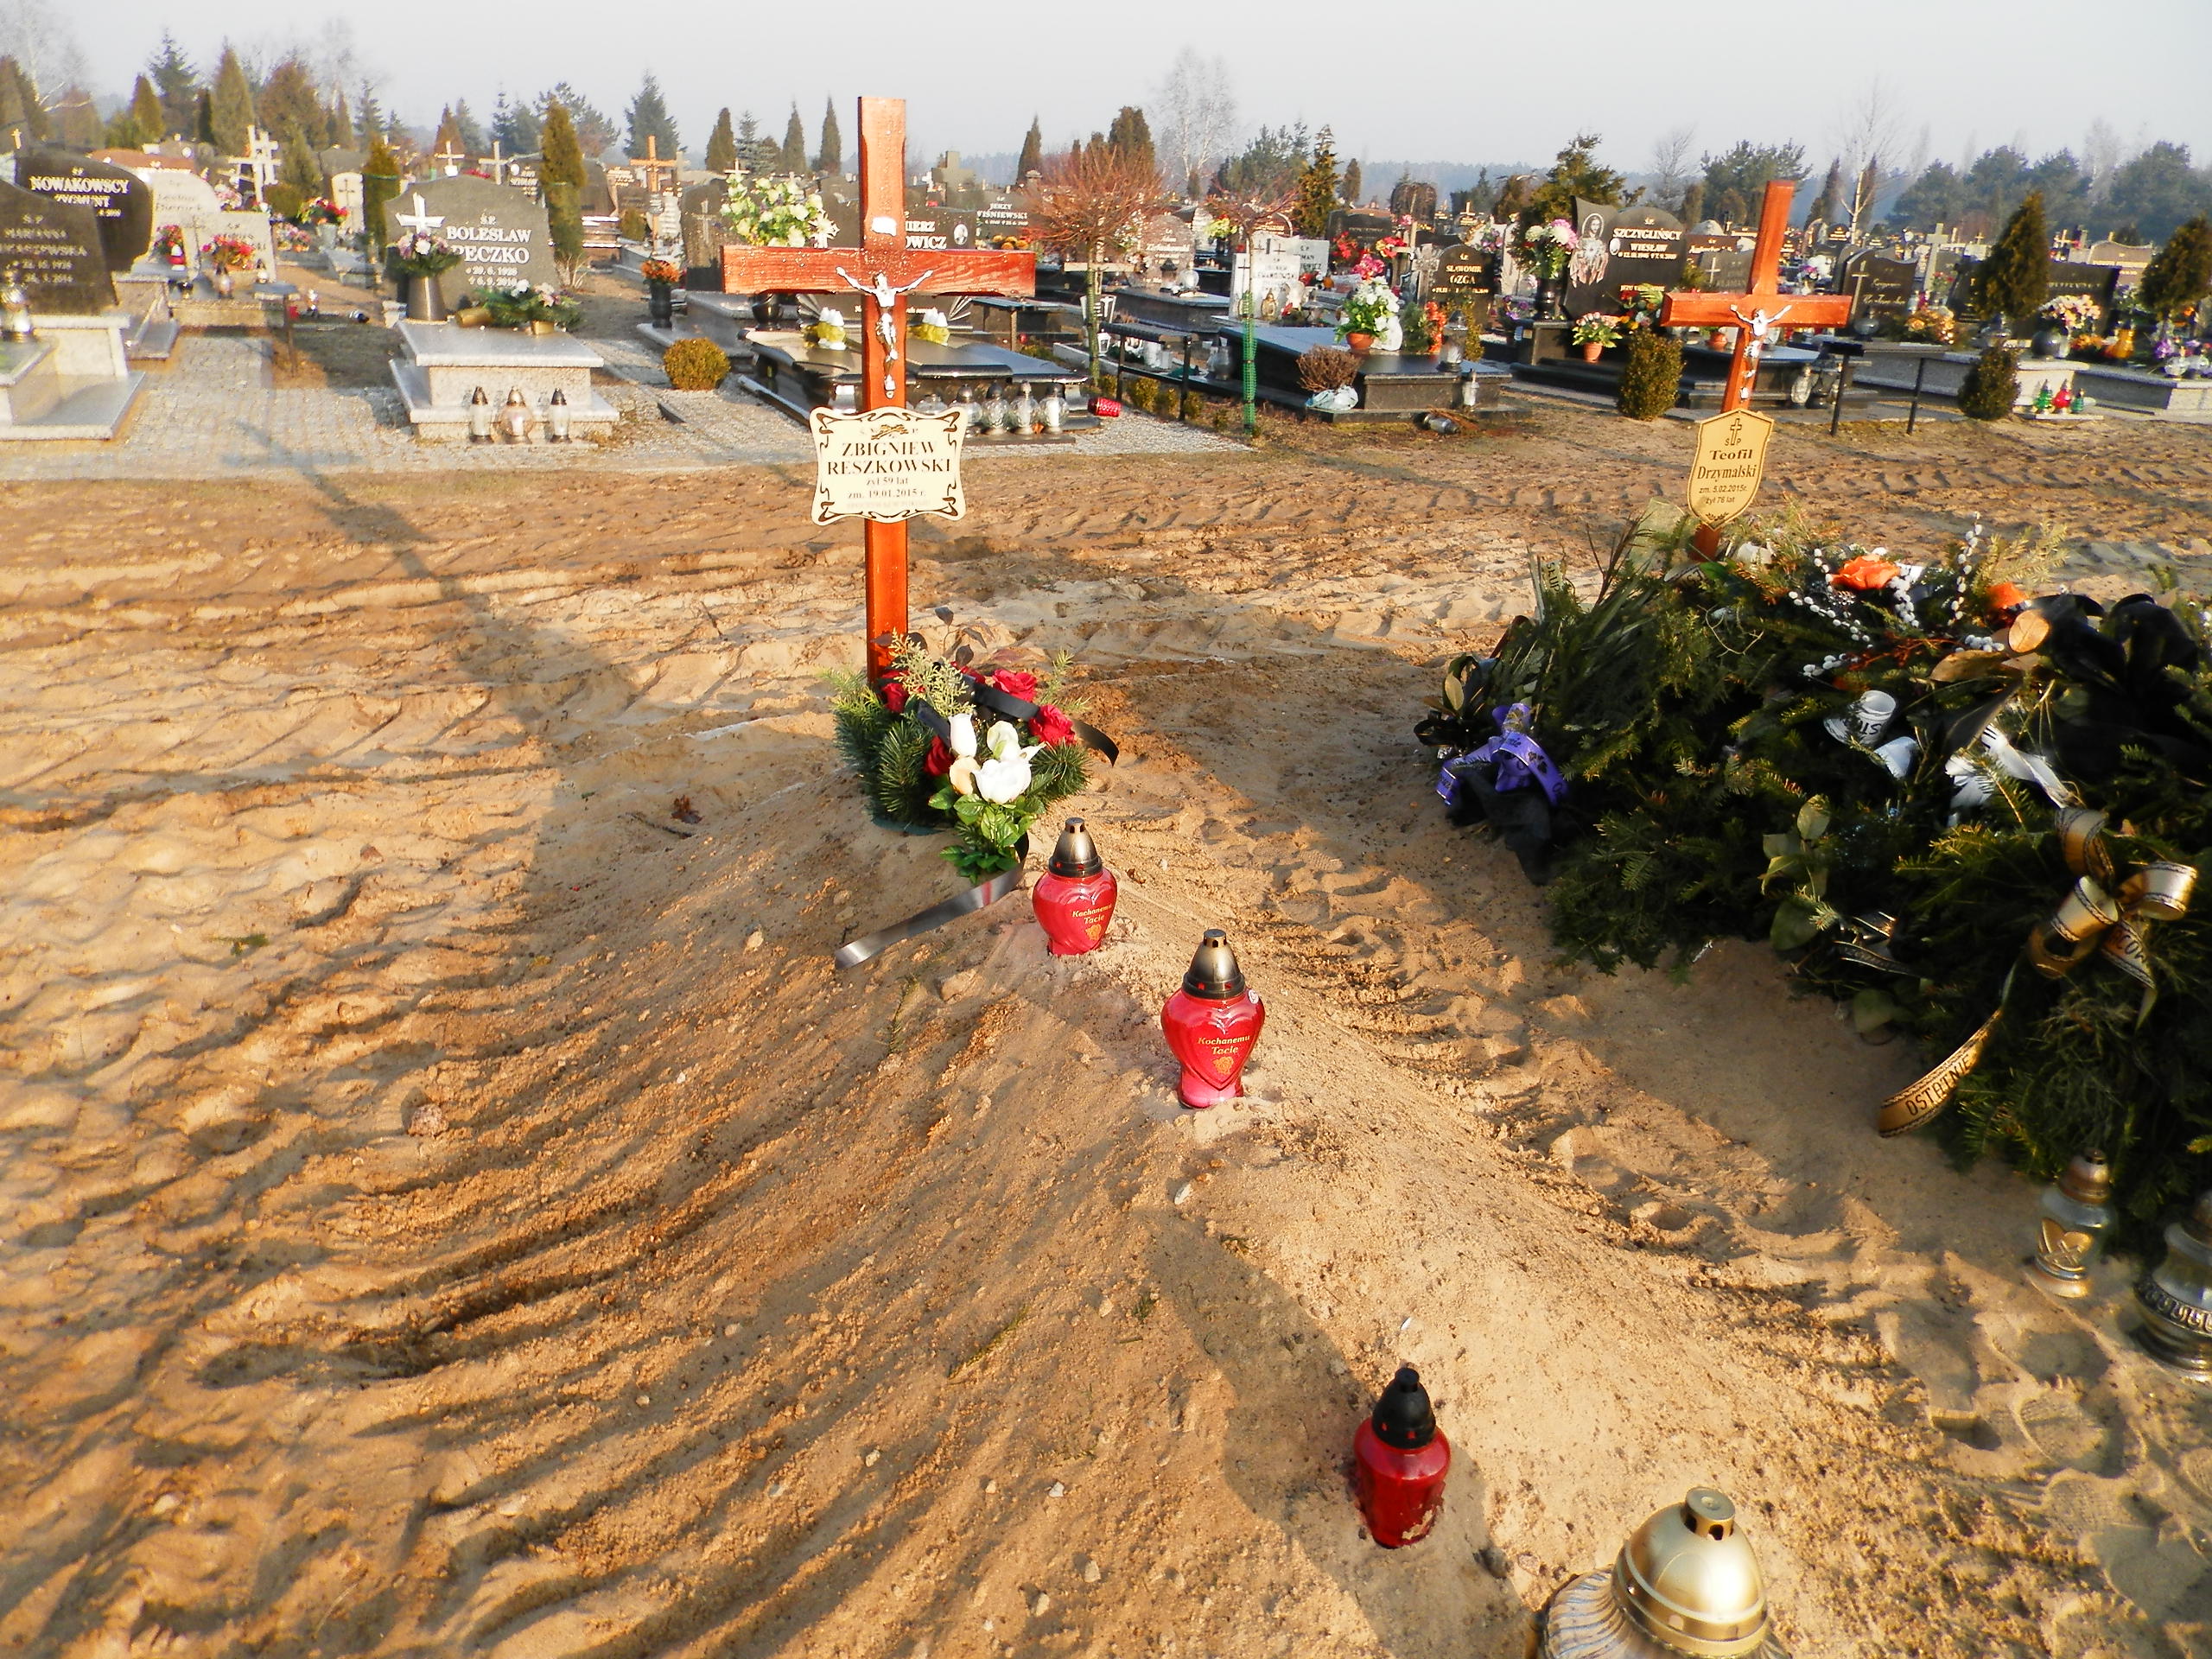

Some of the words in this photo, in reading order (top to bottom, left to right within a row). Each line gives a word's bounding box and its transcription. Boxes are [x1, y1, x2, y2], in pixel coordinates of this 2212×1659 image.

[29, 175, 130, 194] NOWAKOWSCY
[906, 220, 936, 232] IERZ
[842, 441, 936, 457] ZBIGNIEW
[1709, 448, 1753, 461] Teofil
[827, 458, 951, 476] RESZKOWSKI
[1697, 464, 1758, 483] Drzymalski
[896, 476, 909, 485] lat
[848, 491, 863, 499] zm.
[868, 487, 917, 499] 19.01.2015
[1084, 914, 1105, 925] Tacie
[1198, 1035, 1250, 1045] Kochanemu
[1211, 1045, 1239, 1055] Tacie
[1905, 1053, 1971, 1116] OSTATNIE
